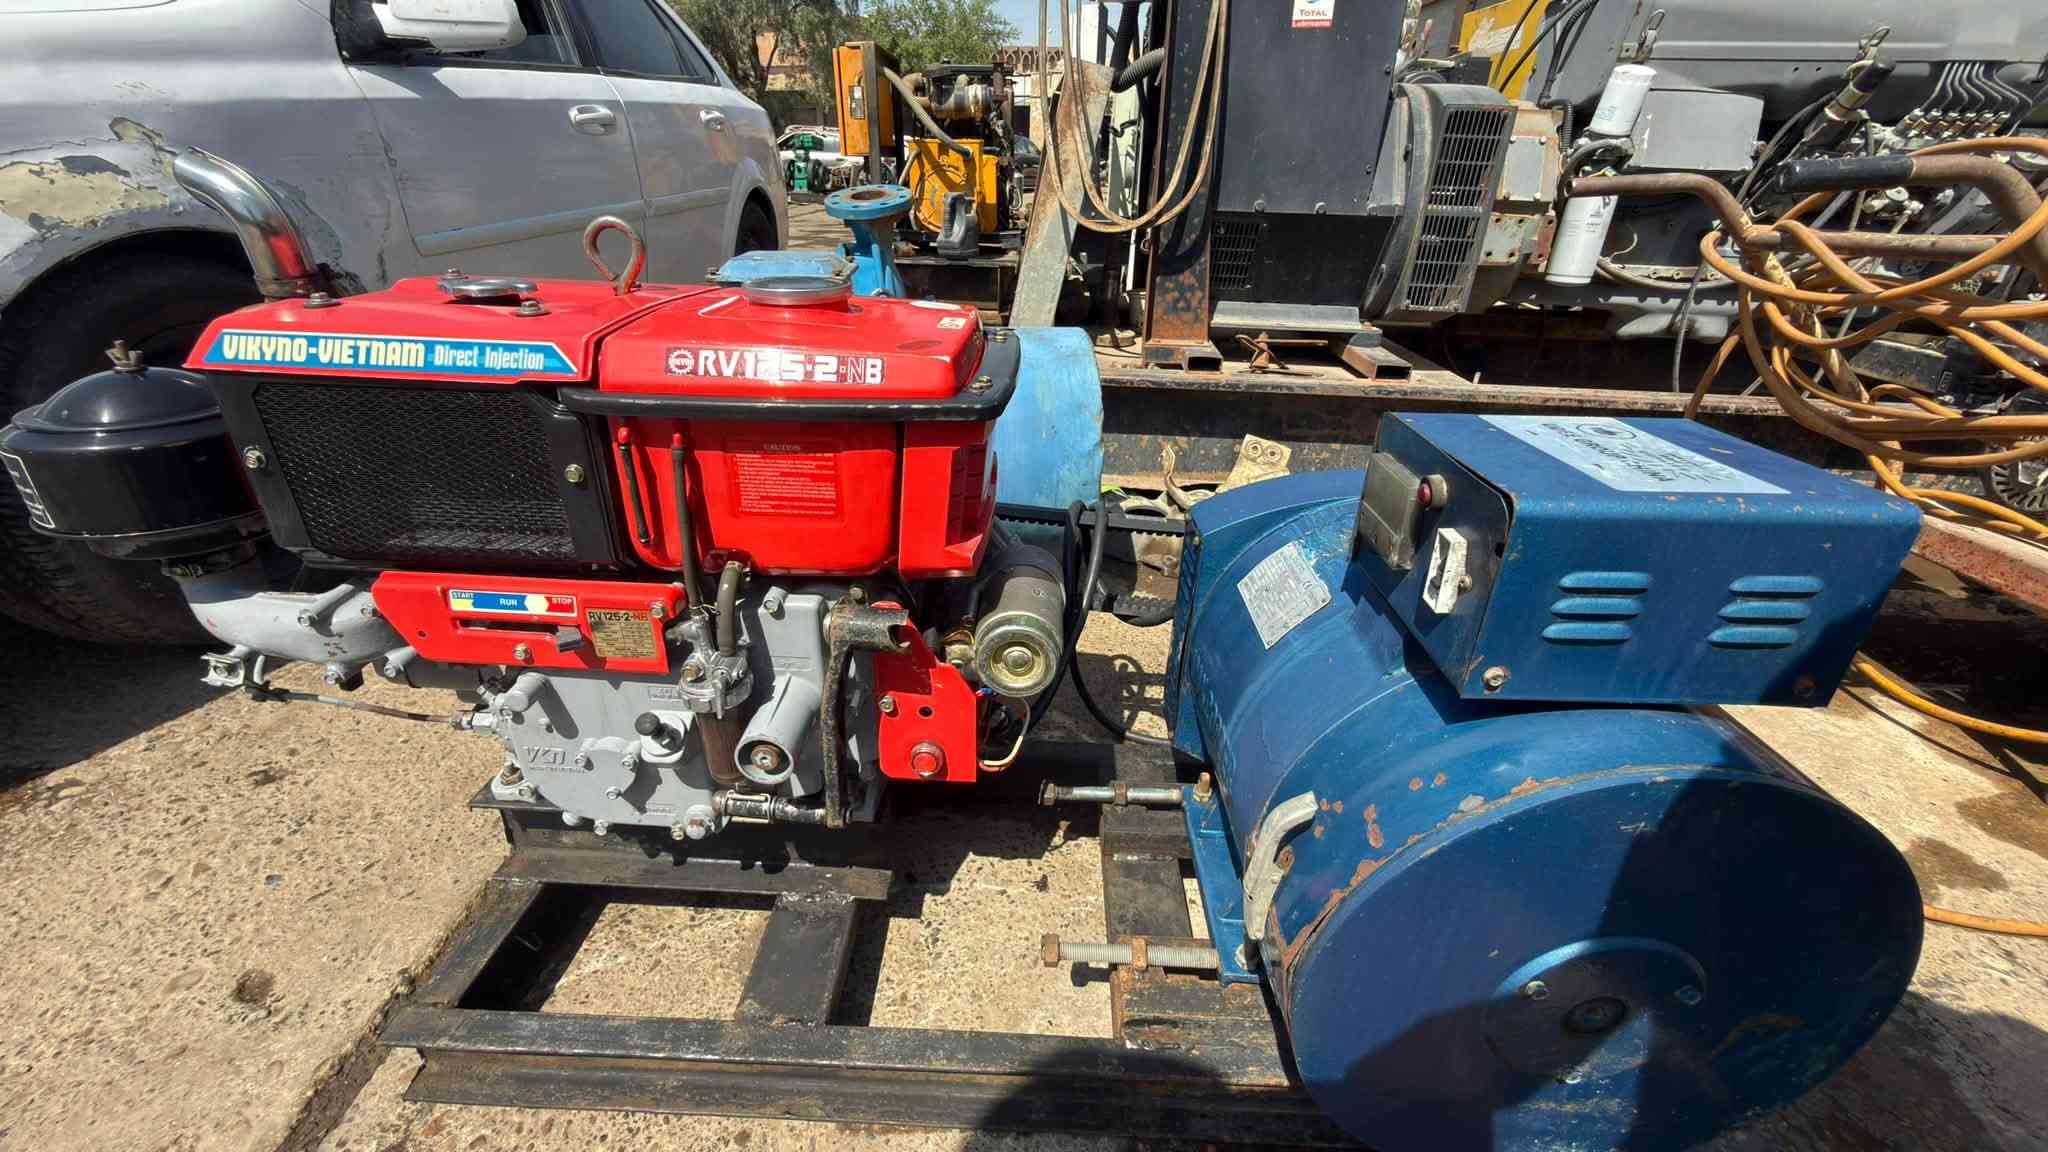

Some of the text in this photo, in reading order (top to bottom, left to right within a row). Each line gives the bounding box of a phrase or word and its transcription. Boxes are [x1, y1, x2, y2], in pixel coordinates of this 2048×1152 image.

[222, 333, 545, 371] VIKYNO-VIETNAM Direct Injection
[452, 592, 475, 600] START
[500, 598, 518, 607] RUN
[551, 597, 573, 605] STOP
